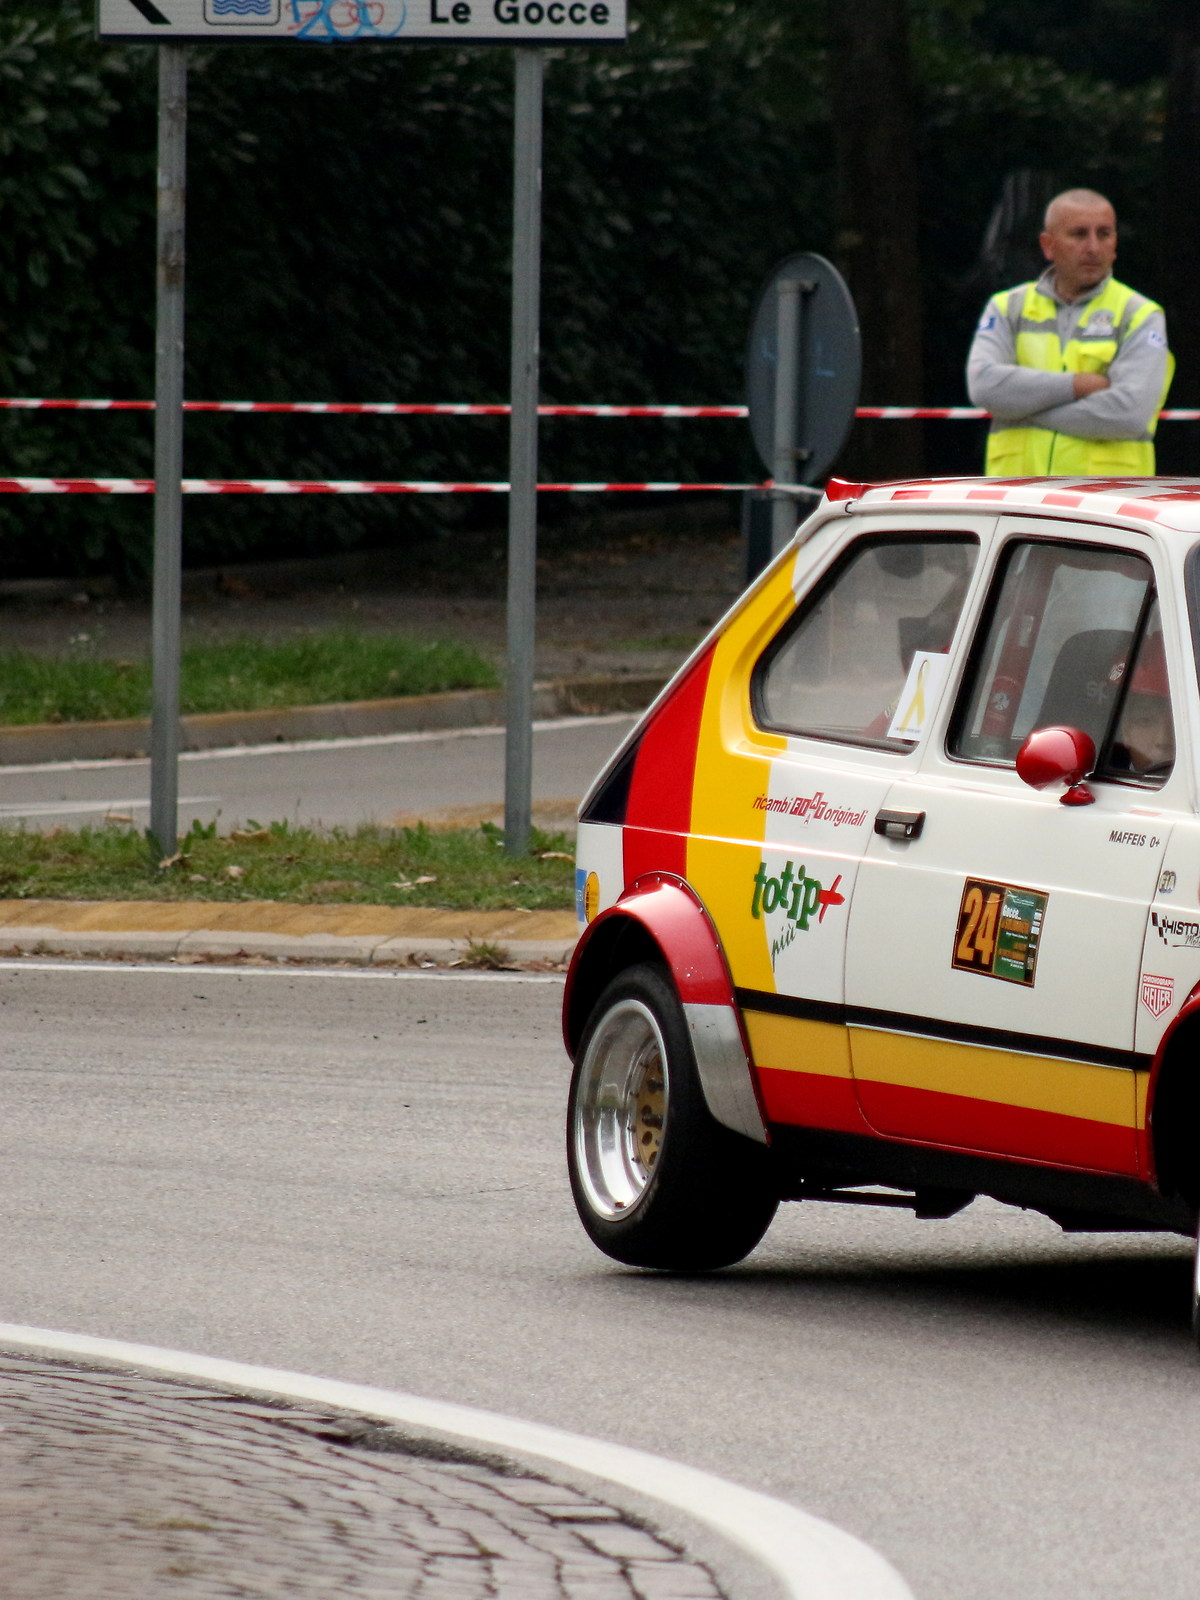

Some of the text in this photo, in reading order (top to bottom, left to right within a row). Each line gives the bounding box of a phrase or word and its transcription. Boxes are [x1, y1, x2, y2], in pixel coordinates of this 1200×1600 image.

[430, 0, 471, 24] Le
[494, 0, 610, 25] Gocce
[752, 794, 793, 814] ricambi
[823, 805, 869, 827] originali
[1109, 830, 1147, 847] MAFFEIS
[957, 887, 1000, 965] 24
[1143, 986, 1172, 1015] HEUER
